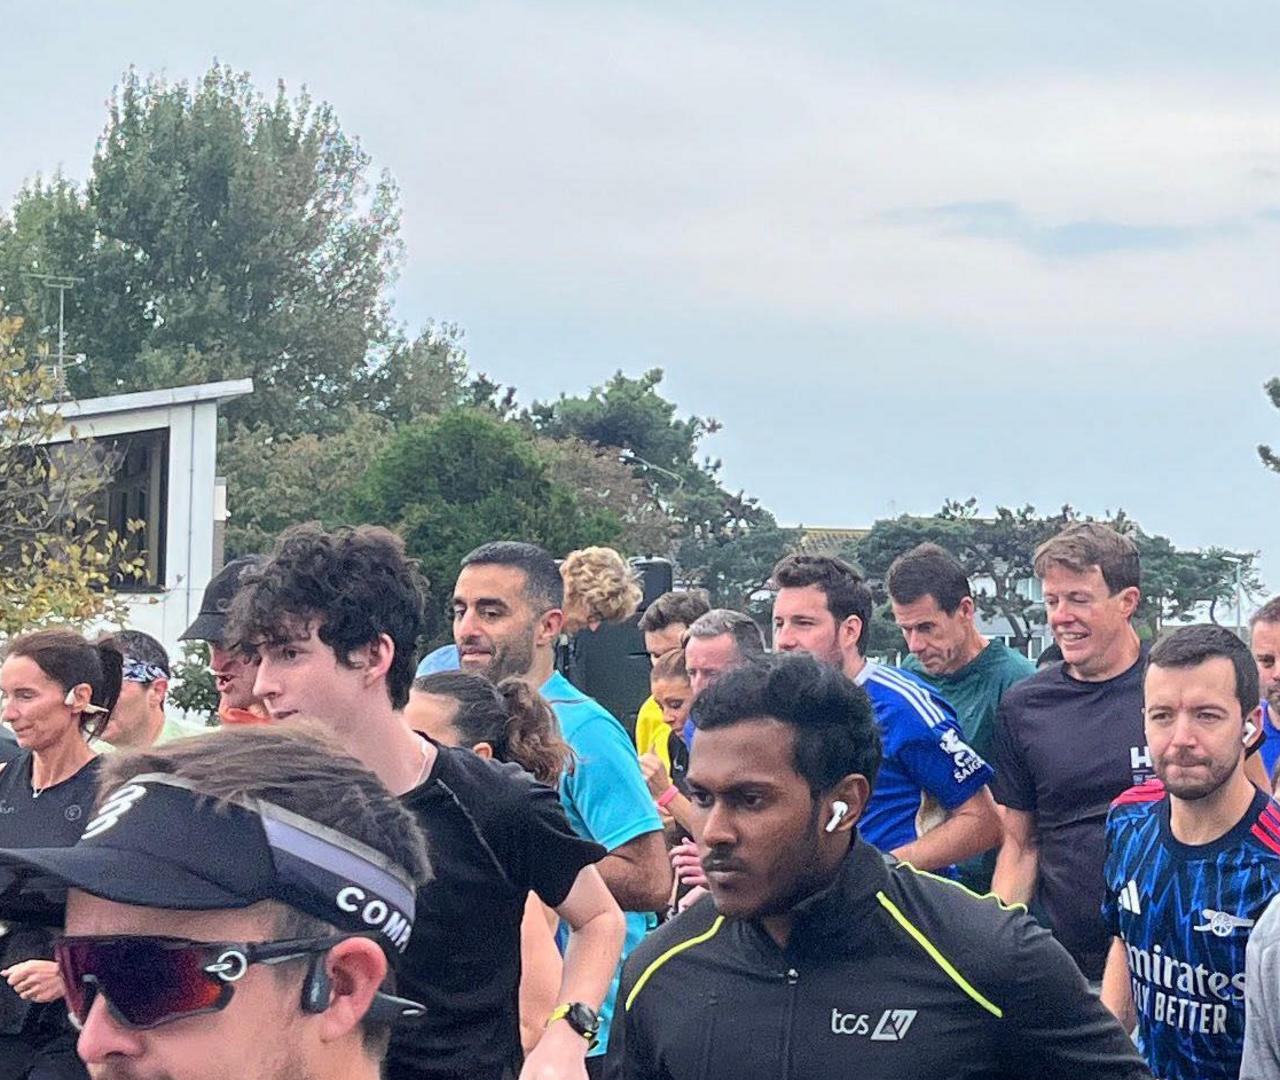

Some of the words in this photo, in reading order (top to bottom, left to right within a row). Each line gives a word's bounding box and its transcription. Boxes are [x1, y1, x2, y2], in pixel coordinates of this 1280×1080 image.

[1122, 940, 1247, 1000] mirates
[831, 1008, 869, 1035] tcs
[1155, 992, 1228, 1034] BETTER
